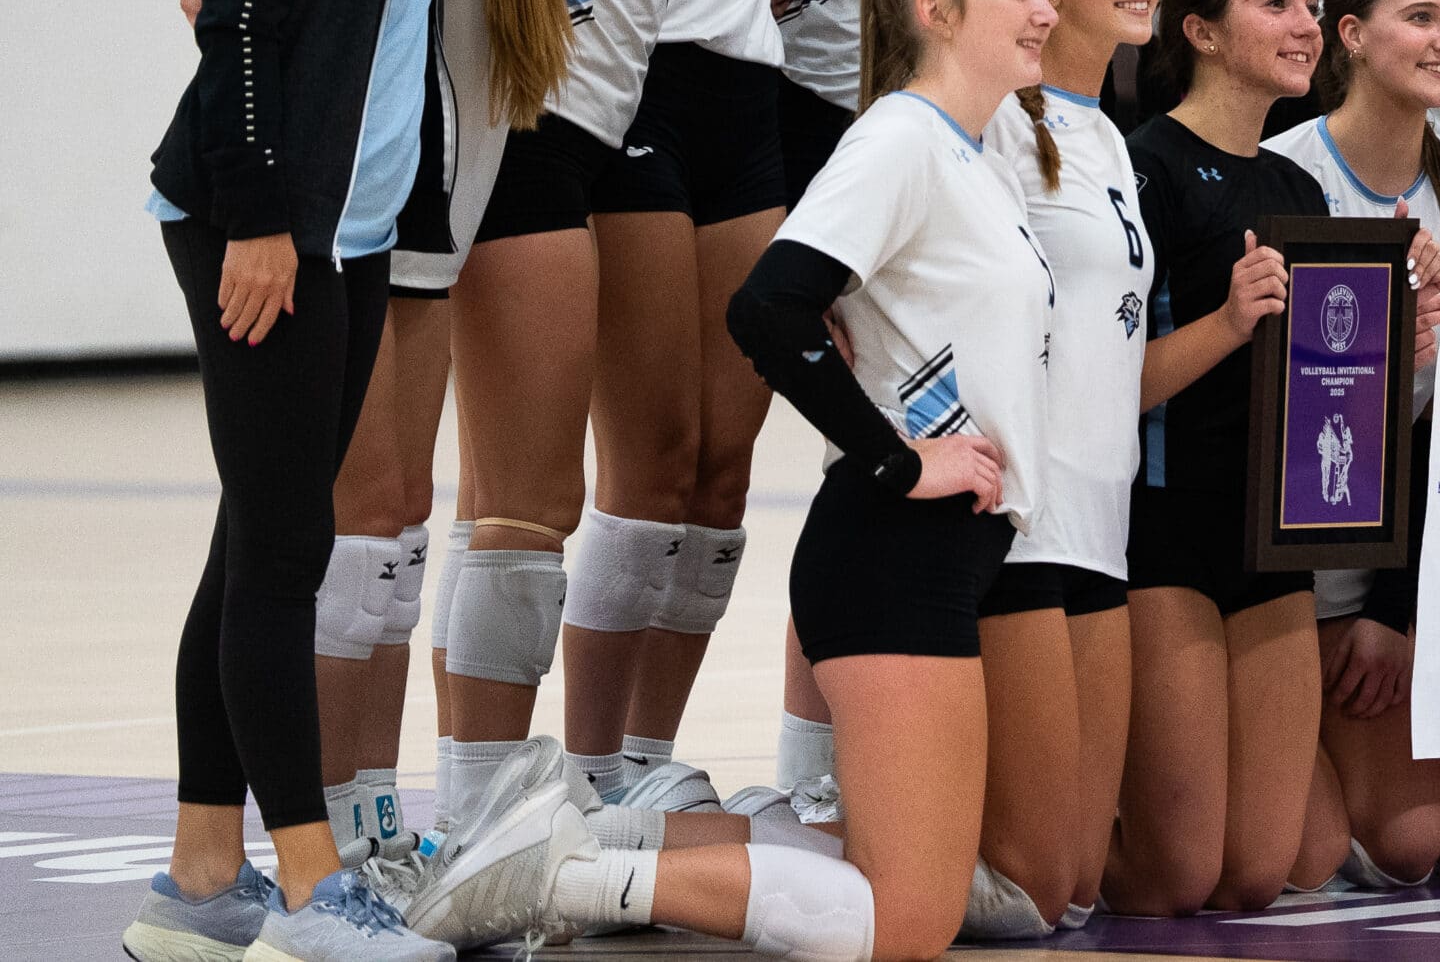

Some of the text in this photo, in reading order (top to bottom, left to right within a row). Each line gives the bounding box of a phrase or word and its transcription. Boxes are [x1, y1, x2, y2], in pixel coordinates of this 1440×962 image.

[1107, 187, 1144, 270] 6
[1300, 365, 1375, 375] VOLLEYBALL INVITATIONAL
[1321, 377, 1355, 386] CHAMPION
[1330, 388, 1345, 396] 2025
